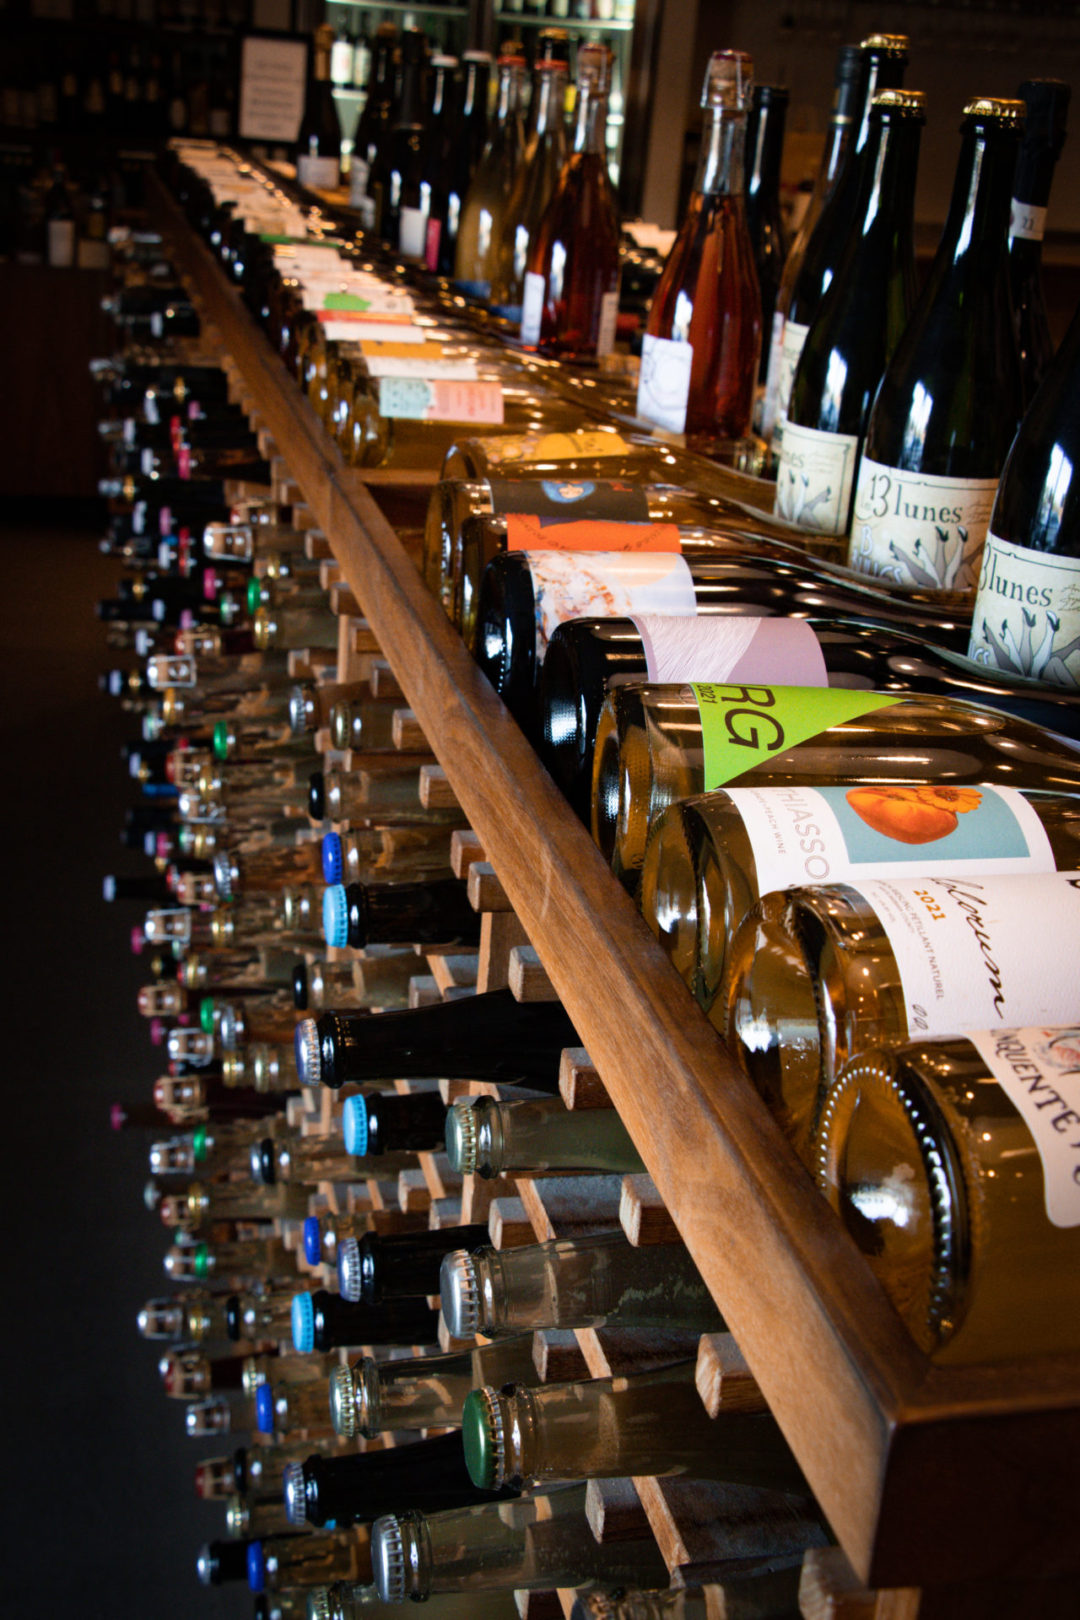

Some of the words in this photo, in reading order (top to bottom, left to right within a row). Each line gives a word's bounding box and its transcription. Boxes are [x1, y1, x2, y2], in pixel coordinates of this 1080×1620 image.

[870, 473, 892, 518] 13
[893, 483, 963, 524] lunes
[989, 552, 1053, 607] lunes
[913, 889, 947, 921] 2021
[928, 955, 946, 1001] NATUREL
